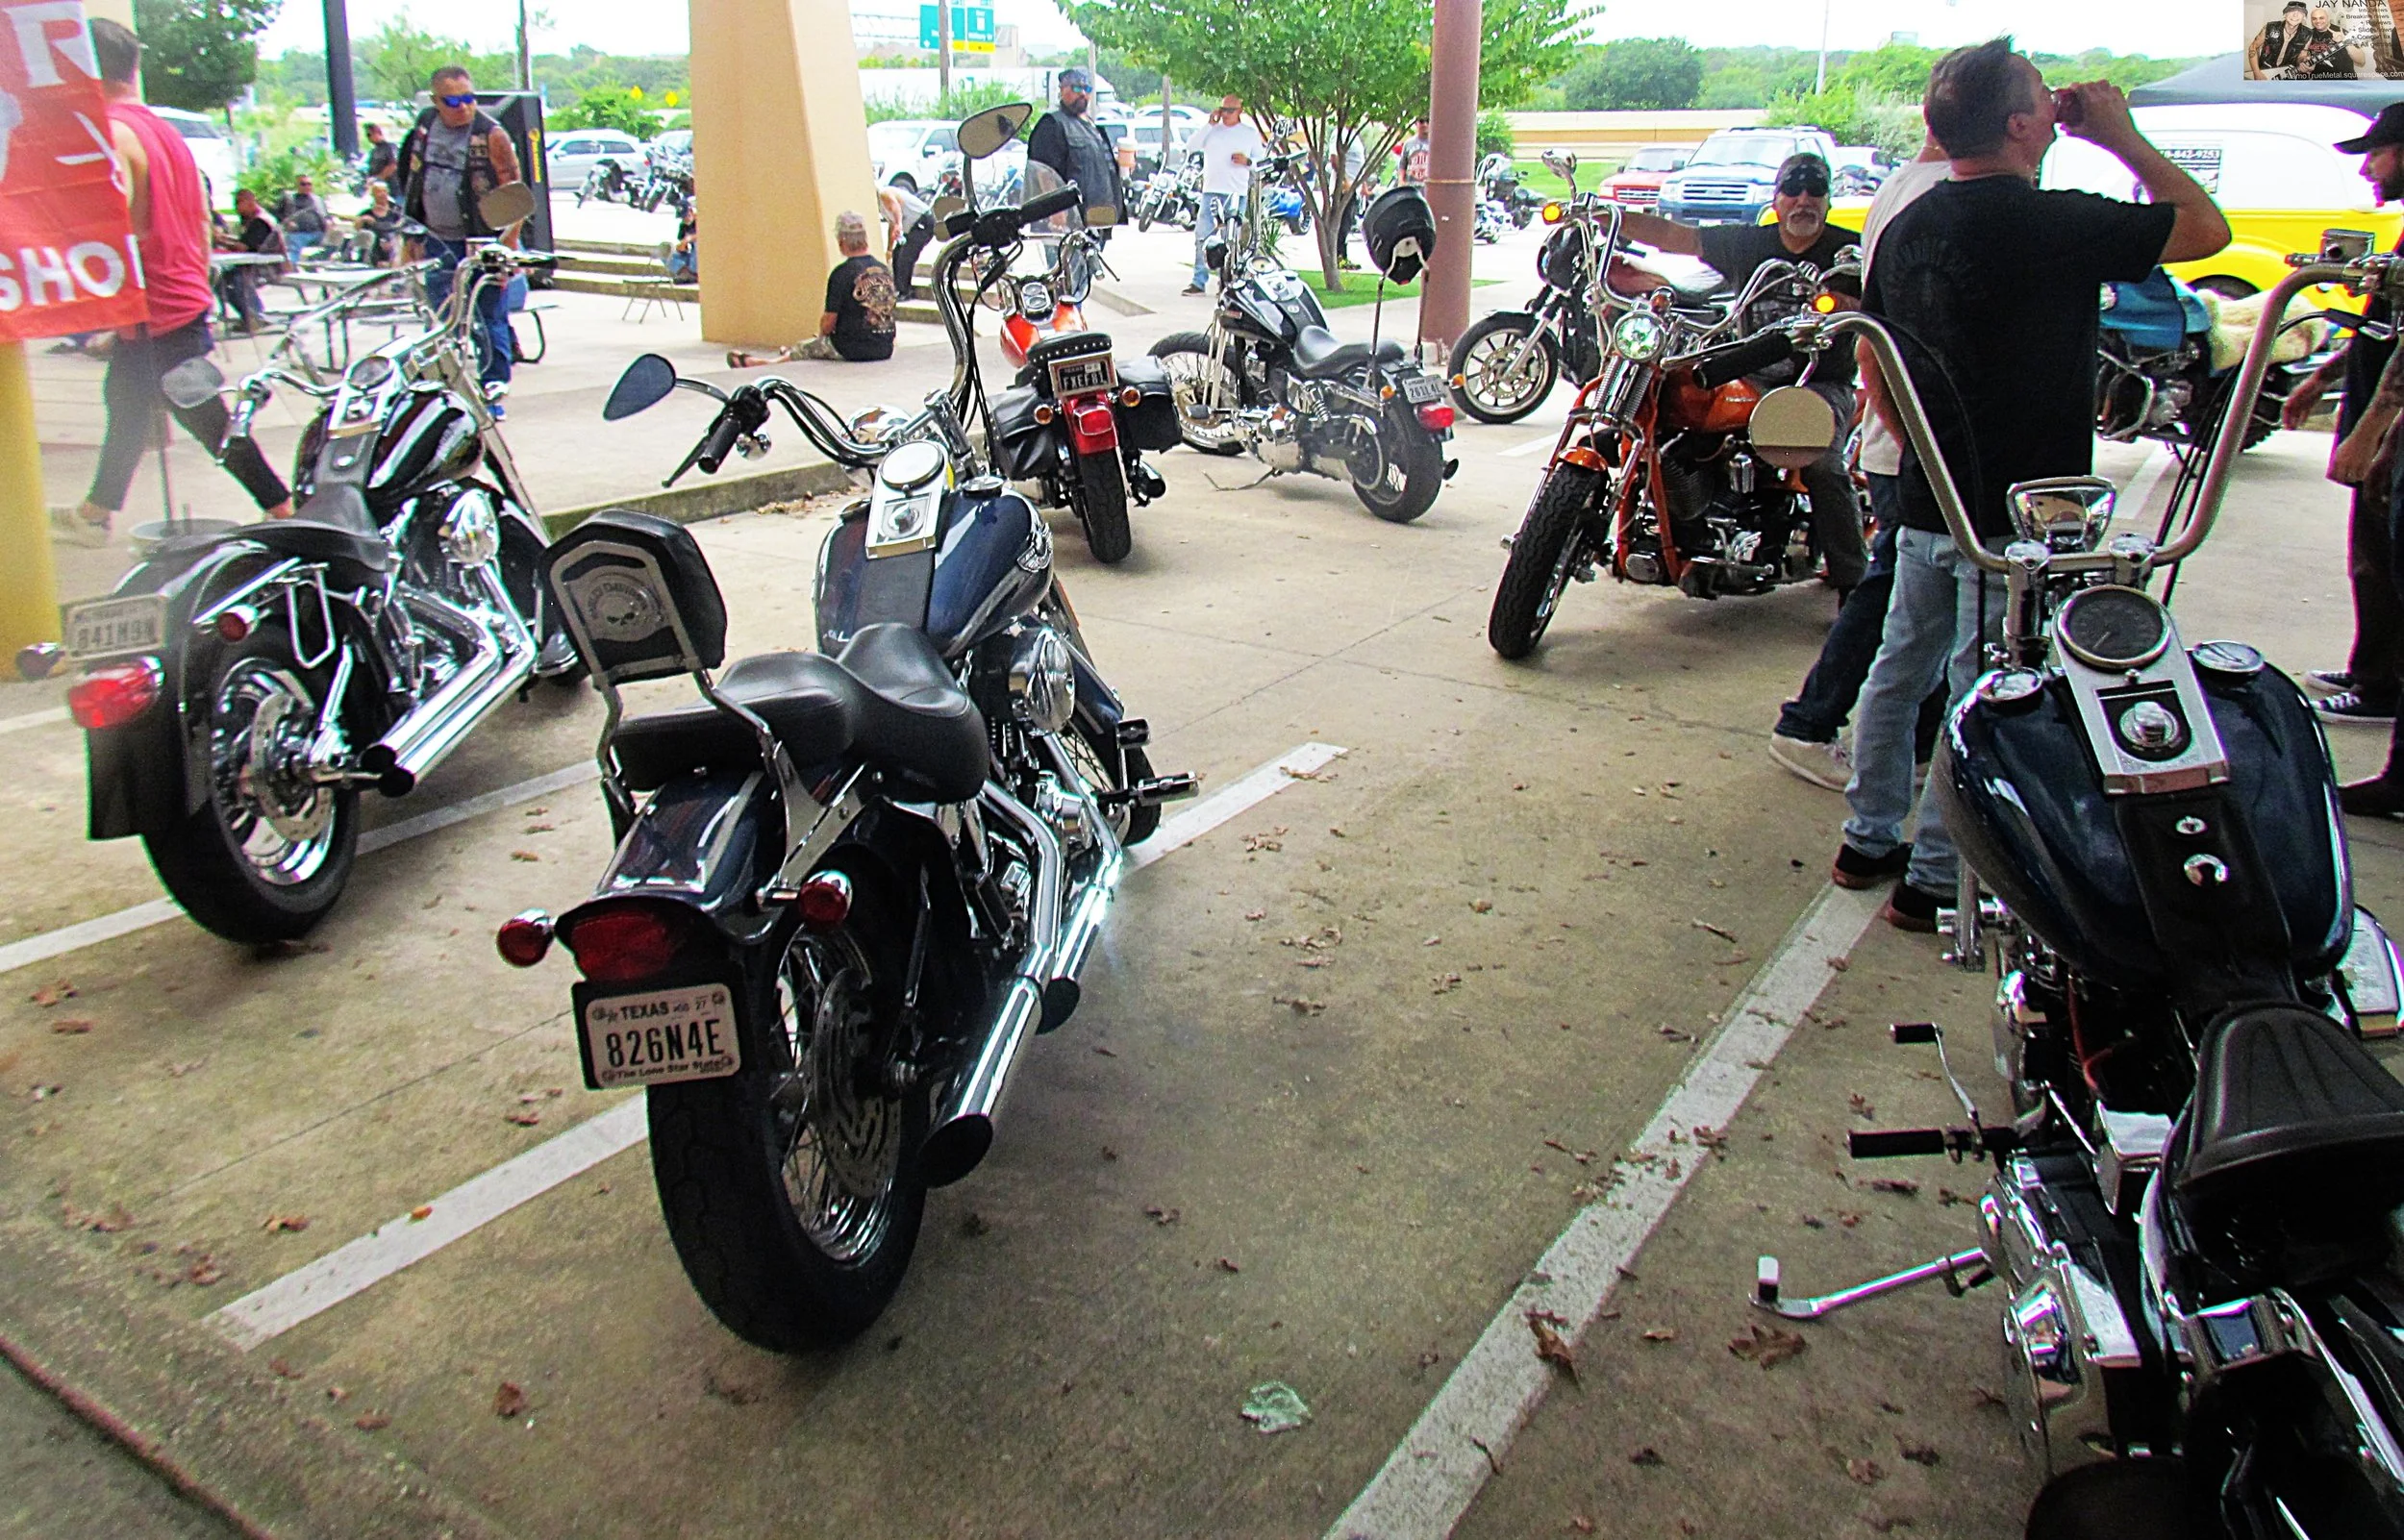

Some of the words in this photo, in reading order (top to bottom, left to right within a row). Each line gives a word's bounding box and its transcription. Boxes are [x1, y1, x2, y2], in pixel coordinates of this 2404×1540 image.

[0, 234, 146, 311] SHO
[620, 1002, 669, 1020] TEXAS
[606, 1019, 724, 1068] 826N4E
[639, 1067, 664, 1077] Lone
[667, 1064, 689, 1073] Star
[692, 1061, 720, 1071] State
